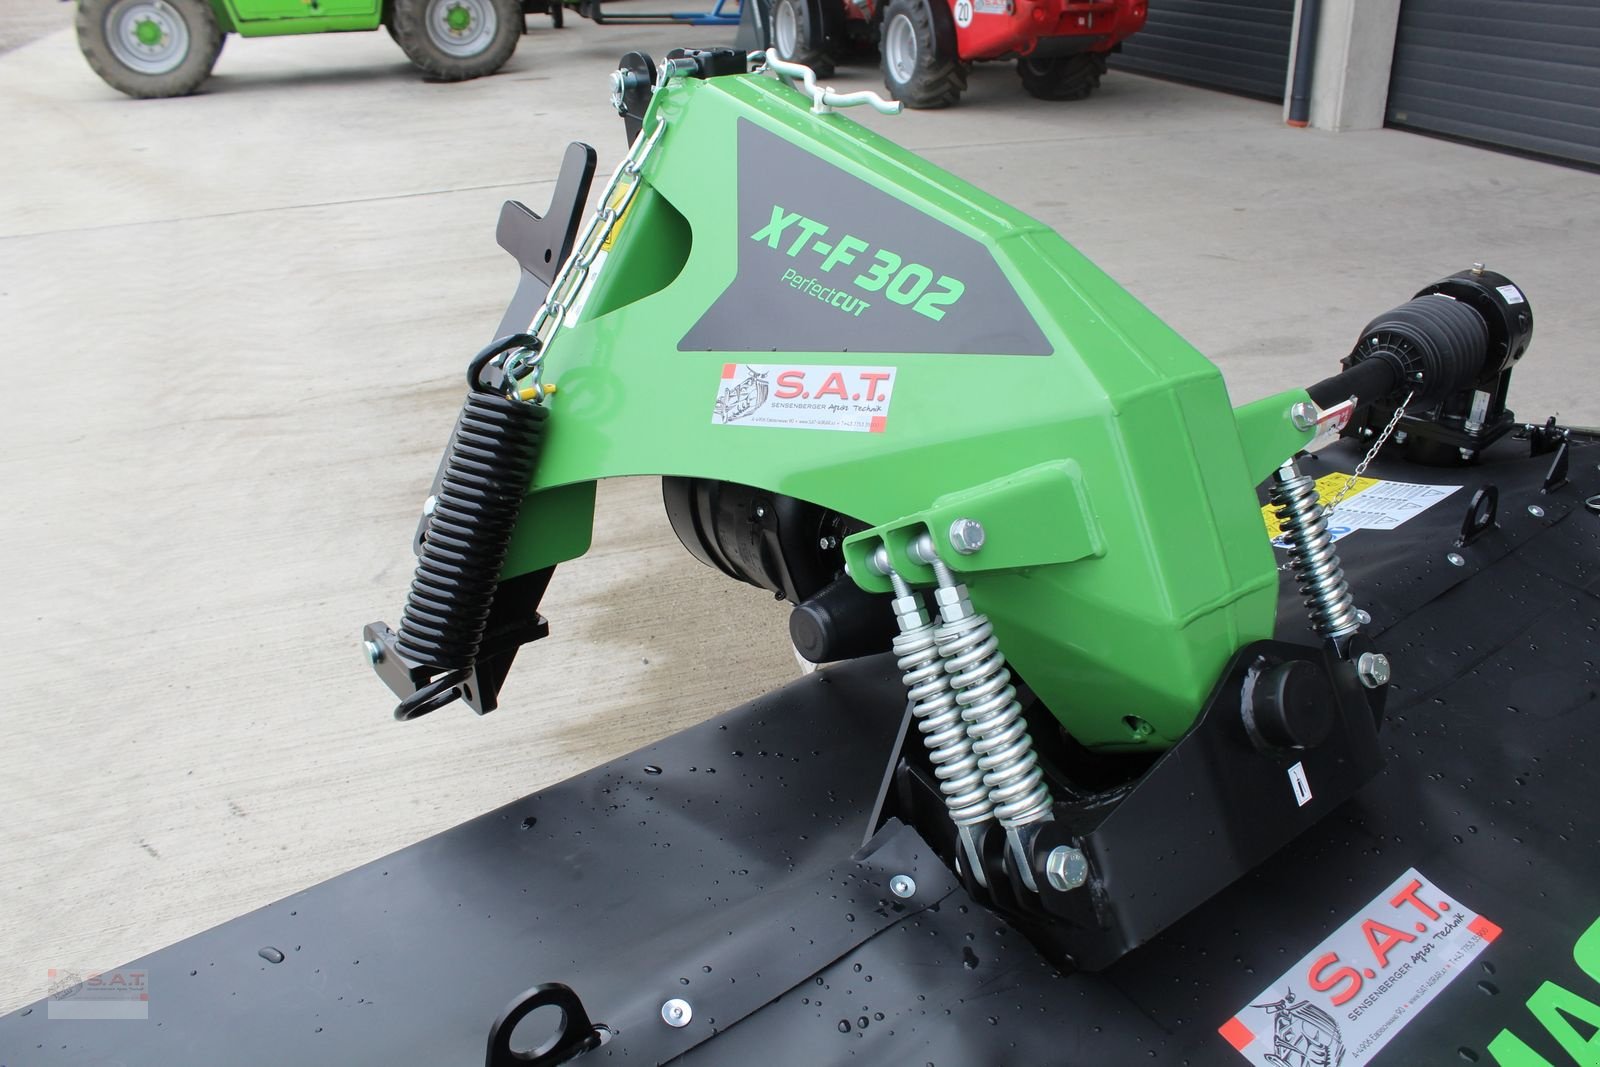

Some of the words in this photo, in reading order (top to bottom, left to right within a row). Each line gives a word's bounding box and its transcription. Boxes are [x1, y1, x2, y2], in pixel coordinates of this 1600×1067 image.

[958, 2, 969, 21] 20
[750, 204, 870, 273] XT-F
[853, 248, 965, 322] 302
[771, 402, 826, 410] SENSENBERGER
[852, 404, 882, 412] Technik
[774, 370, 890, 402] S.A.T.
[1307, 879, 1450, 1007] S.A.T.
[1347, 962, 1413, 1021] SENSENBERGER
[1432, 912, 1465, 941] Technik
